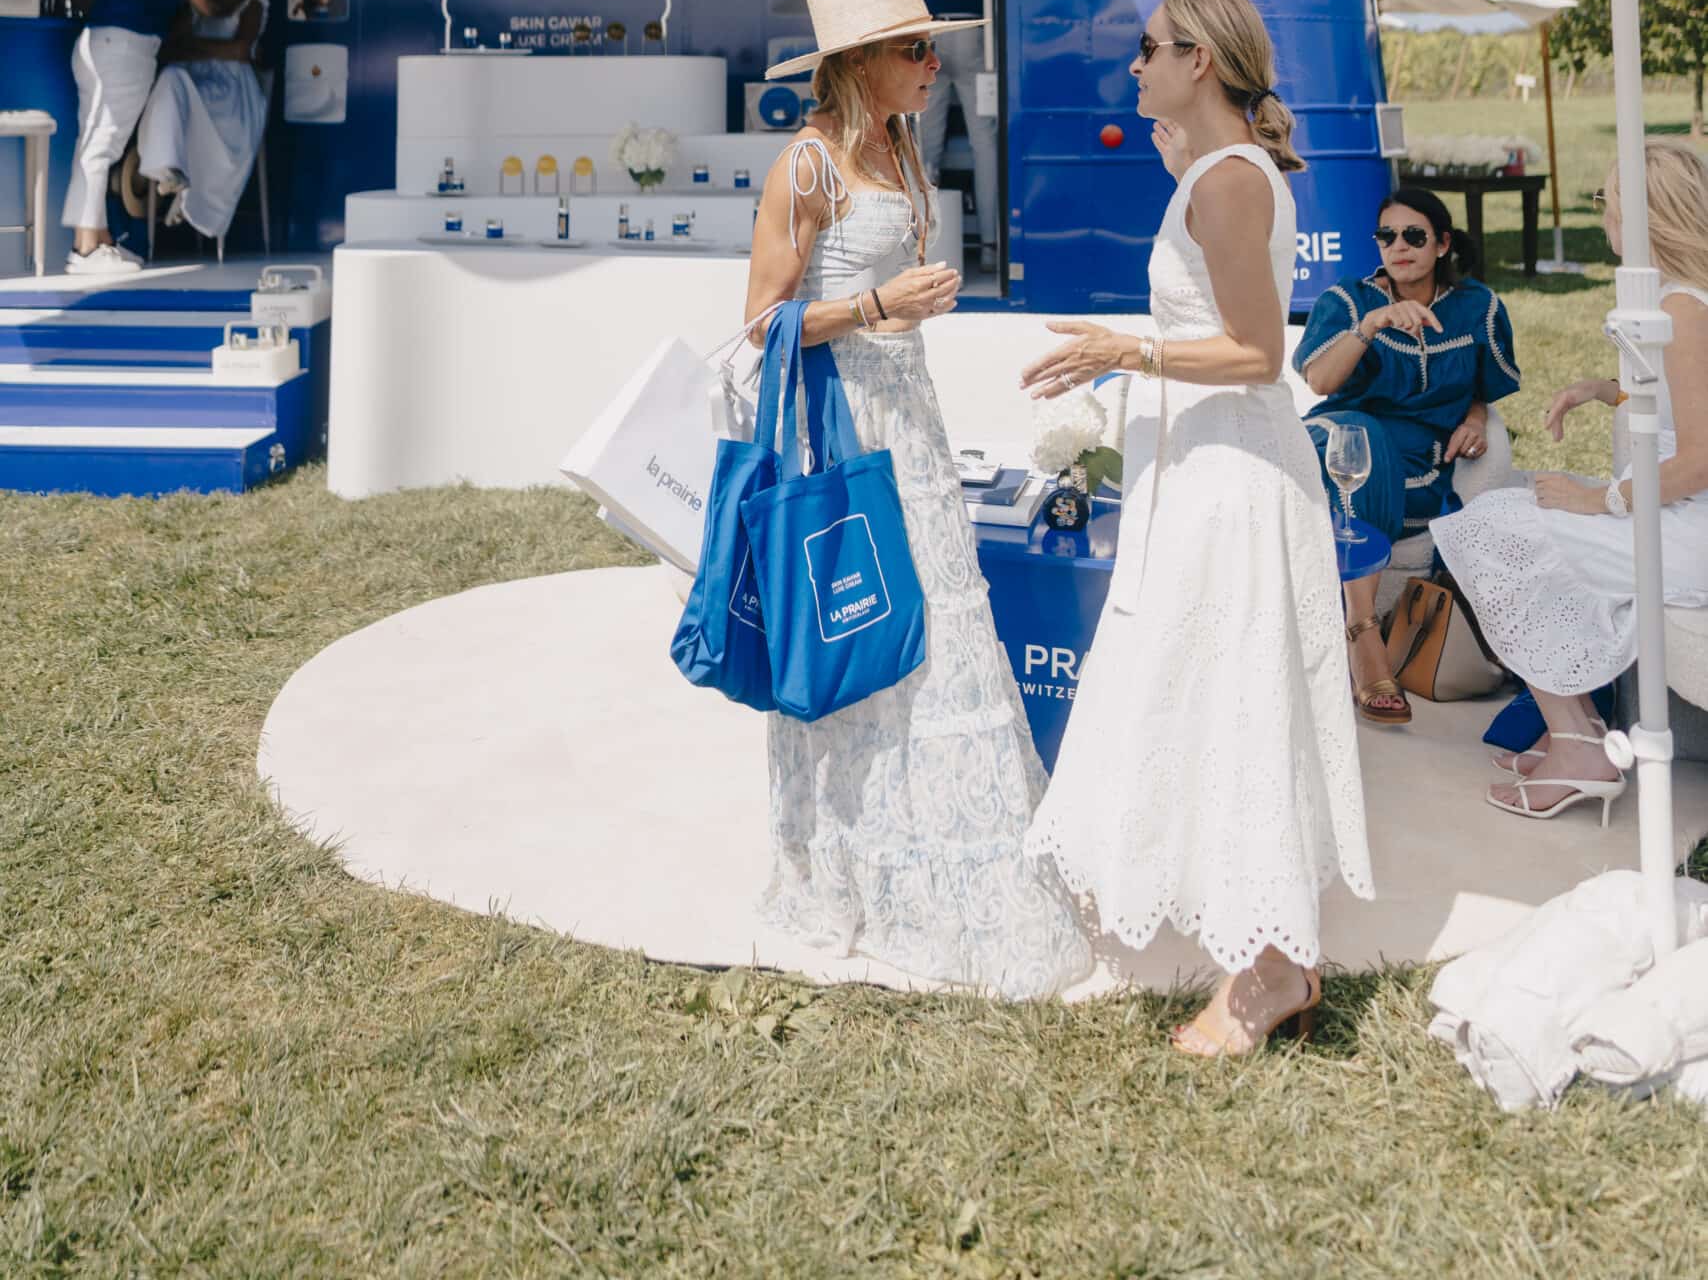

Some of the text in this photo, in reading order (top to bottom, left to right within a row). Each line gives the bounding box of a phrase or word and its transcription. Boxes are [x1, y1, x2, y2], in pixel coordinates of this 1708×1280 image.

[510, 16, 602, 30] SKIN CAVIAR
[513, 33, 546, 47] UXE
[646, 455, 702, 511] la prairie
[830, 610, 842, 622] LA
[841, 593, 878, 617] PRAIRIE
